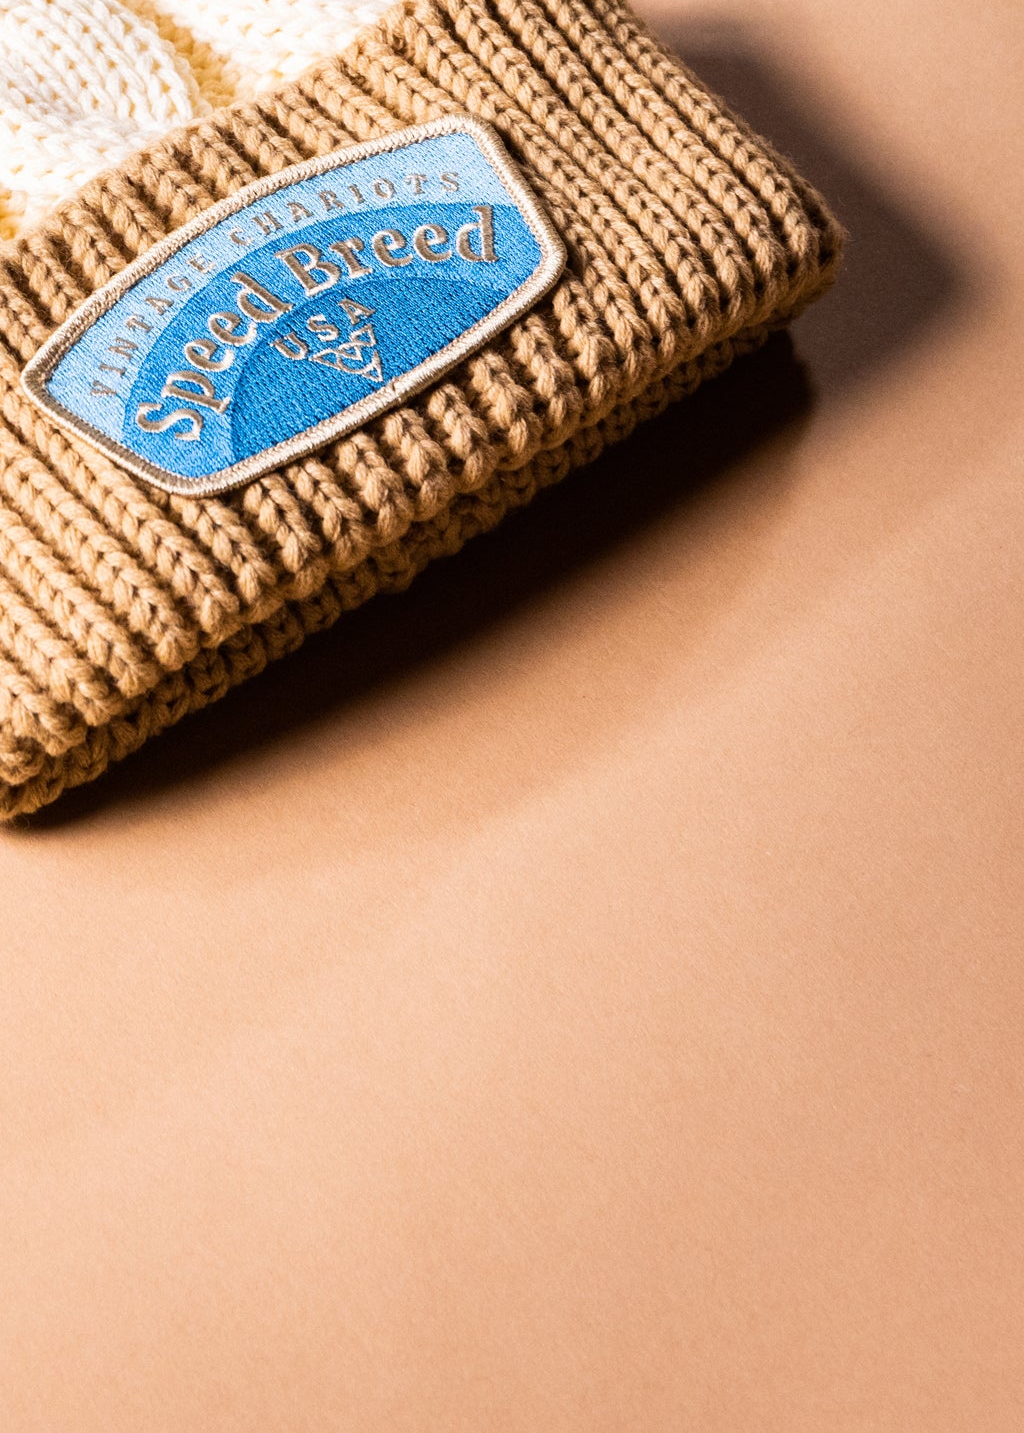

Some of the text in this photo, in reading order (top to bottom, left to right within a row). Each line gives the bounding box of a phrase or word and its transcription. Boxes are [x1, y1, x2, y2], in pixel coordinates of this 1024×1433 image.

[90, 169, 463, 399] VINTAGE CHARIOTS
[136, 205, 500, 442] Speed Breed
[270, 296, 376, 361] USA
